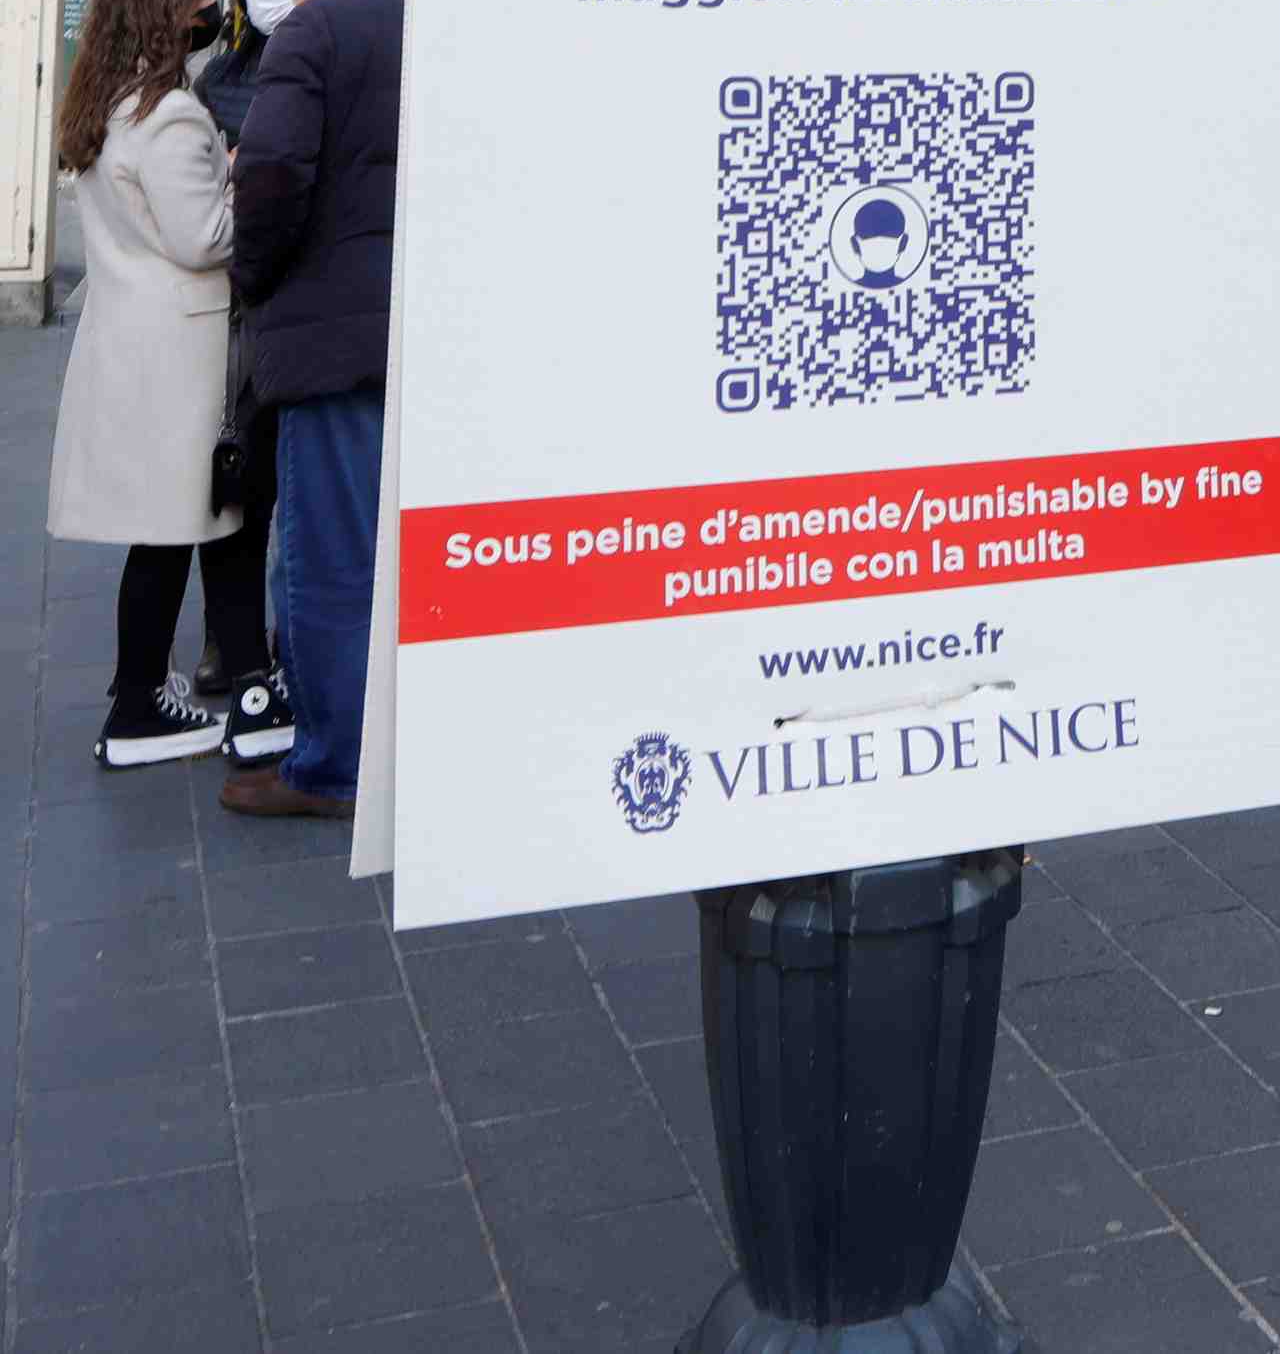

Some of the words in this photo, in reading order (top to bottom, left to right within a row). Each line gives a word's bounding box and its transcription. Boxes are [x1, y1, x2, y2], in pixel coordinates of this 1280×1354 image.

[445, 532, 552, 568] Sous
[567, 523, 686, 565] peine
[700, 476, 1129, 545] d'amende/punishable
[1141, 472, 1185, 509] by
[1195, 465, 1263, 499] fine
[665, 554, 833, 607] punibile
[846, 545, 918, 582] con
[932, 539, 965, 573] la
[978, 529, 1085, 569] multa
[759, 622, 1004, 680] www.nice.fr
[708, 730, 879, 801] VILLE
[900, 720, 979, 778] DE
[998, 698, 1141, 765] NICE
